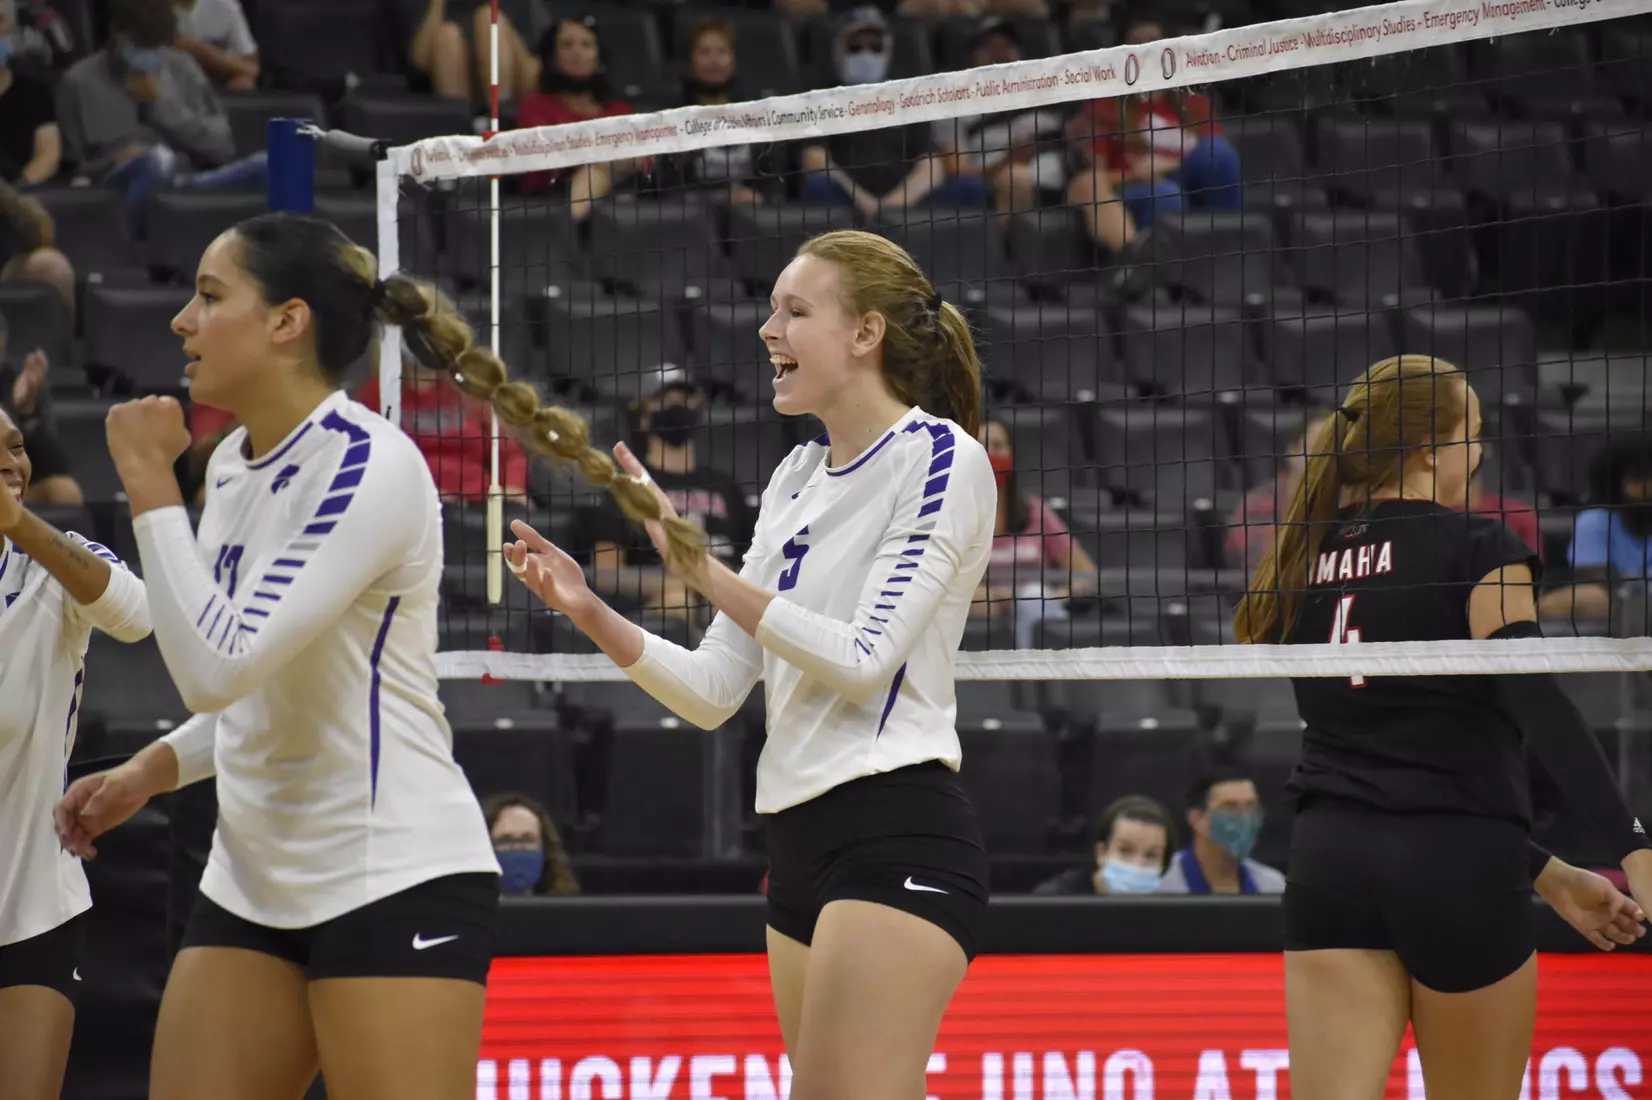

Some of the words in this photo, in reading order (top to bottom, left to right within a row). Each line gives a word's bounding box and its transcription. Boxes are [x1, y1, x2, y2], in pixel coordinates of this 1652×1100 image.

[772, 107, 817, 126] Community
[976, 79, 1000, 97] Public
[1064, 68, 1091, 84] Social
[1091, 64, 1117, 81] Work
[1186, 49, 1220, 68] Aviation
[1226, 37, 1266, 62] Criminal
[1268, 37, 1299, 55] Justice
[1302, 24, 1382, 49] Multidisciplinary
[1383, 15, 1416, 36] Studies
[1424, 6, 1479, 30] Emergency
[1482, 0, 1547, 20] Management
[1308, 540, 1393, 586] MAHA
